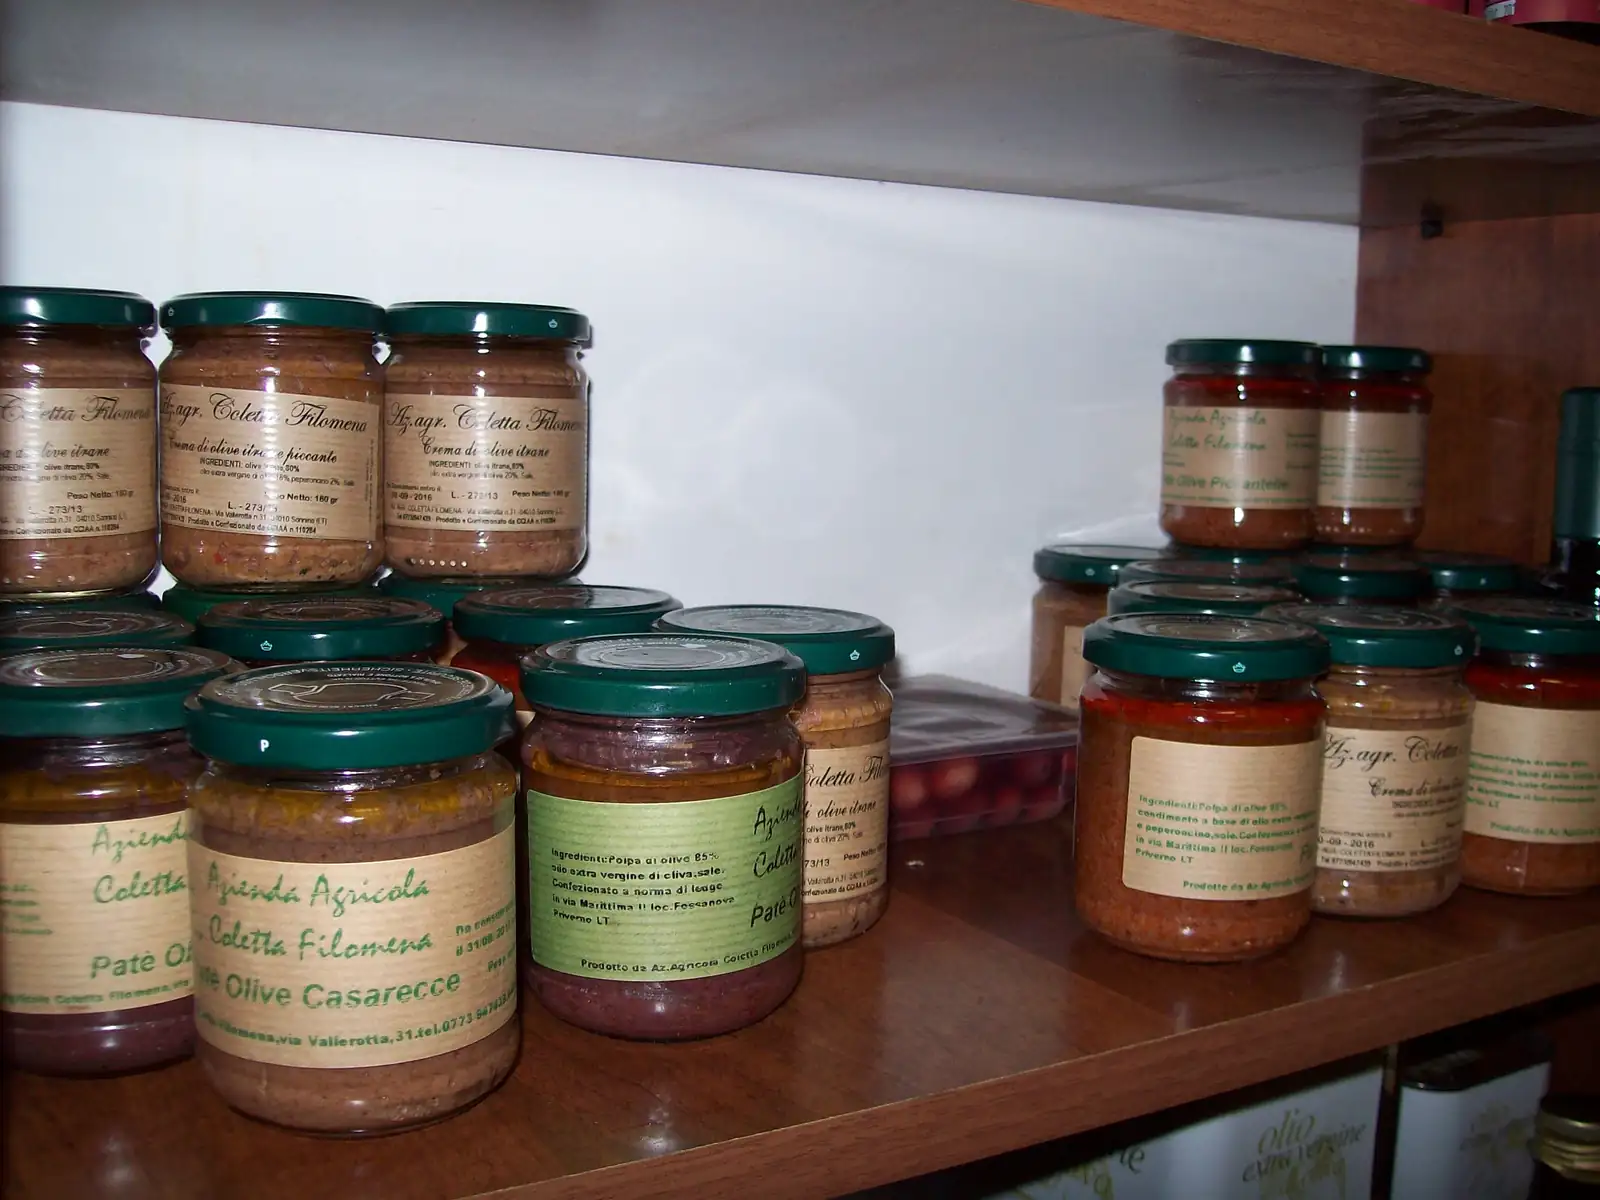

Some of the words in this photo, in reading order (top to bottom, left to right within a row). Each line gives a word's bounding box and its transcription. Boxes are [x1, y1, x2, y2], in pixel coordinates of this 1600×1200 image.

[285, 400, 368, 432] Filomena
[197, 437, 210, 453] di
[210, 438, 239, 454] olive
[283, 448, 338, 466] piccante
[421, 435, 460, 456] Crema
[414, 493, 432, 501] 2016
[260, 739, 269, 752] P
[817, 800, 847, 818] olive
[1138, 809, 1199, 824] condimento
[1350, 838, 1375, 848] 2016
[551, 848, 641, 866] Ingredienti:Polpa
[843, 852, 860, 861] Peso
[1135, 847, 1177, 862] Priverno
[569, 867, 597, 878] extra
[600, 871, 645, 882] vergine
[648, 869, 661, 880] di
[207, 861, 301, 906] Azienda
[309, 867, 430, 918] Agricola
[551, 879, 619, 896] Confezionato
[633, 888, 672, 896] norma
[676, 884, 688, 895] di
[562, 896, 576, 906] via
[579, 898, 634, 911] Marittima
[552, 908, 592, 924] Priverno
[596, 916, 610, 926] LT
[209, 914, 287, 957] Coletta
[297, 927, 434, 961] Filomena
[580, 958, 628, 972] Prodotto
[632, 964, 647, 972] da
[723, 949, 759, 964] Coletta
[226, 972, 292, 1007] Olive
[302, 972, 461, 1010] Casarecce
[1257, 1108, 1316, 1155] olio
